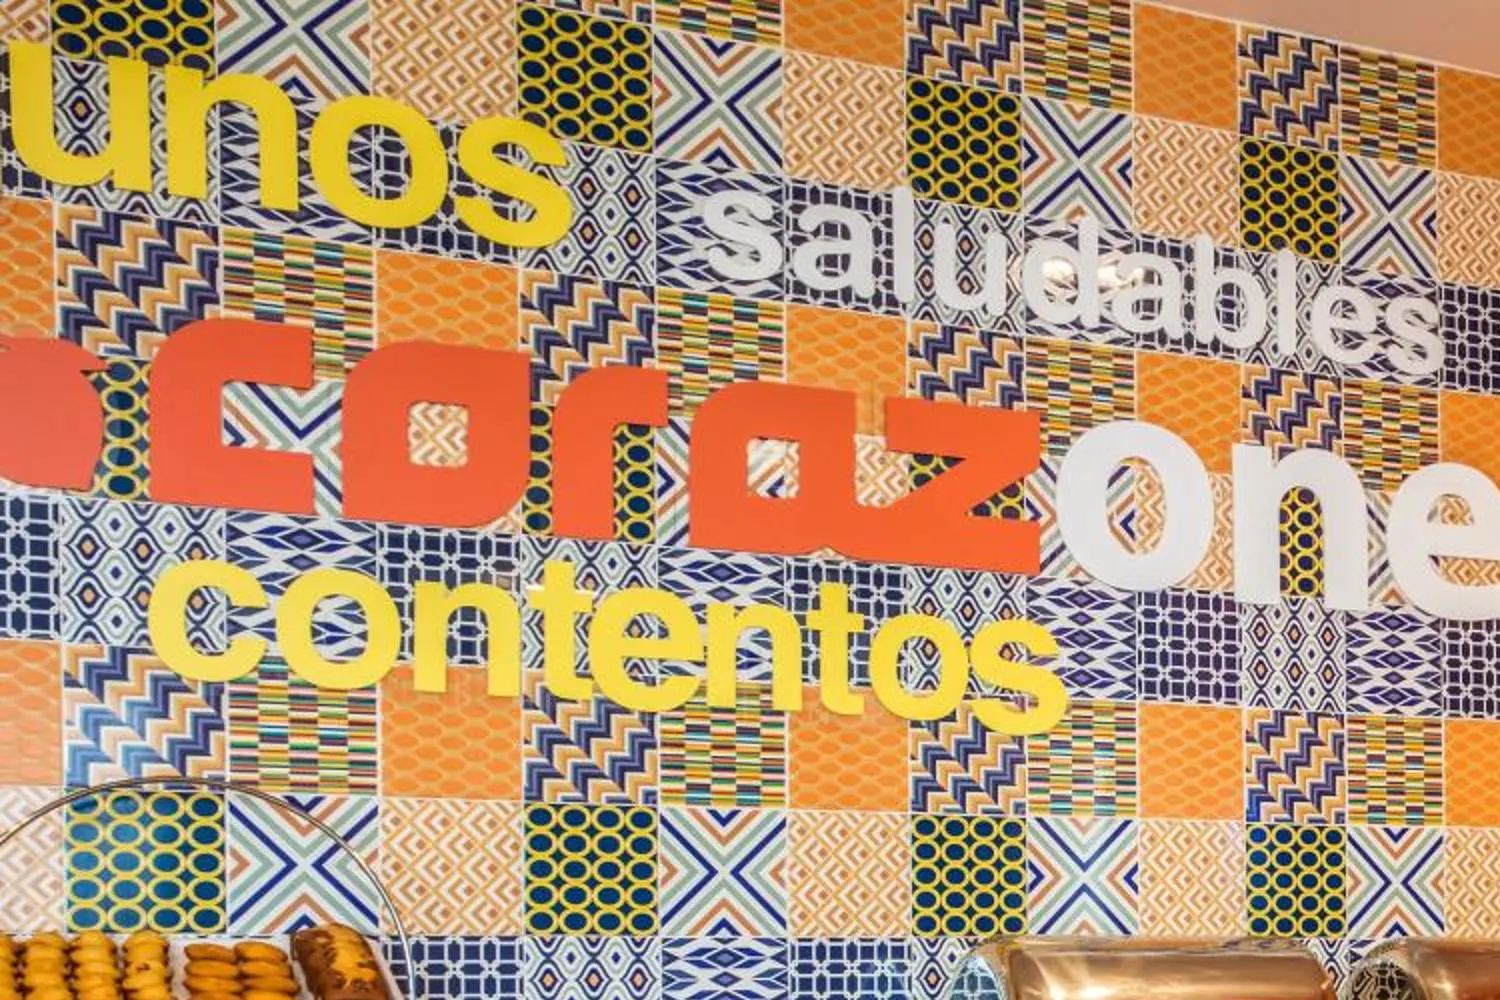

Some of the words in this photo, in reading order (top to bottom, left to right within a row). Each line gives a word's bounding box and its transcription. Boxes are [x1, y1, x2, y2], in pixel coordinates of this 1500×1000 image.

[9, 38, 572, 250] unos
[703, 186, 1444, 375] saludables
[148, 559, 1069, 736] contentos
